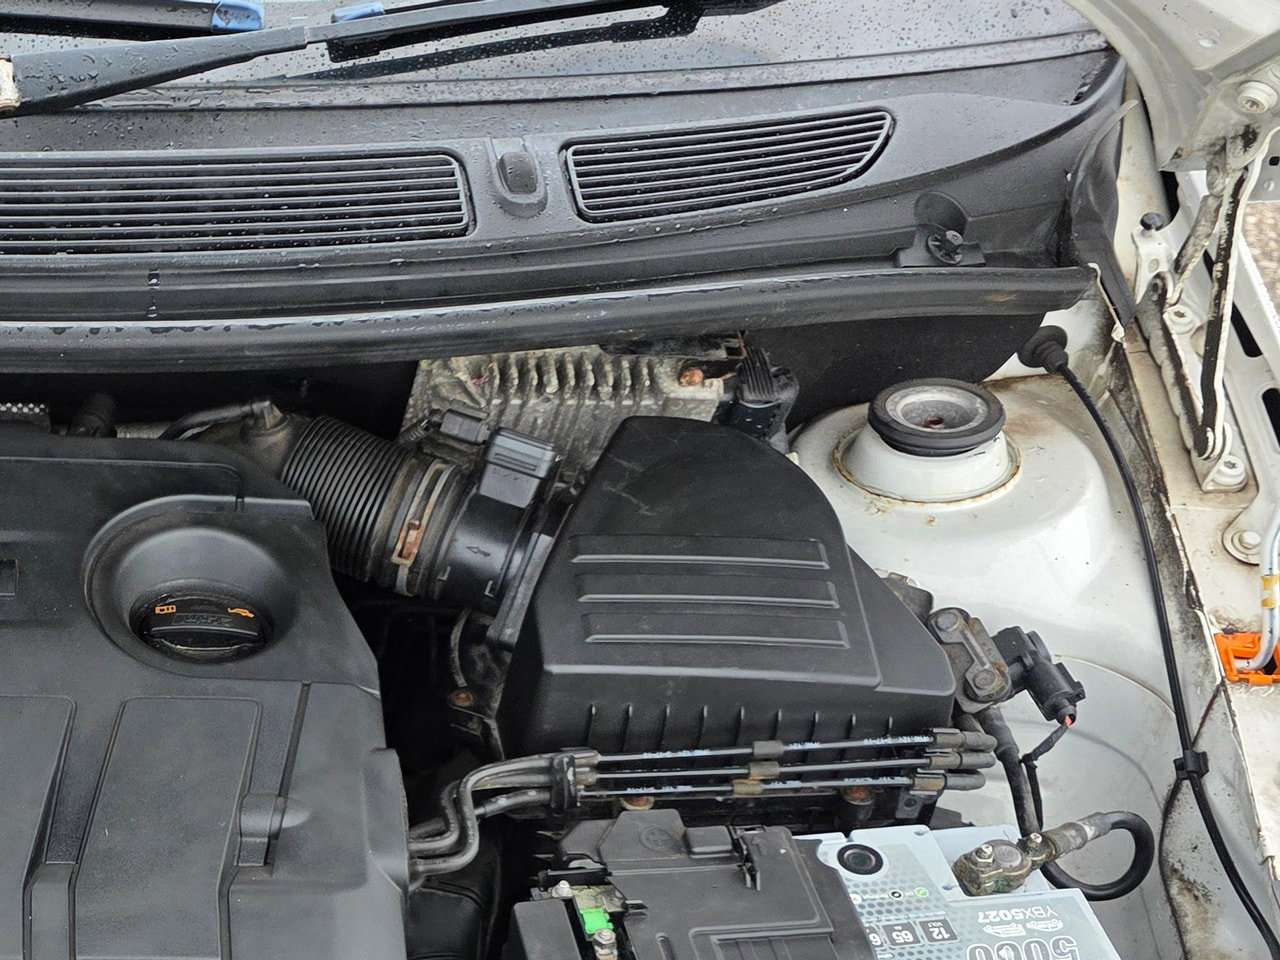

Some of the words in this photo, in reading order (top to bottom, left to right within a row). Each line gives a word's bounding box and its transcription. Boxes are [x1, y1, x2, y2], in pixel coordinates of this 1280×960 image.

[976, 905, 1059, 923] YBX5027
[891, 930, 914, 943] 65
[928, 926, 951, 939] 12
